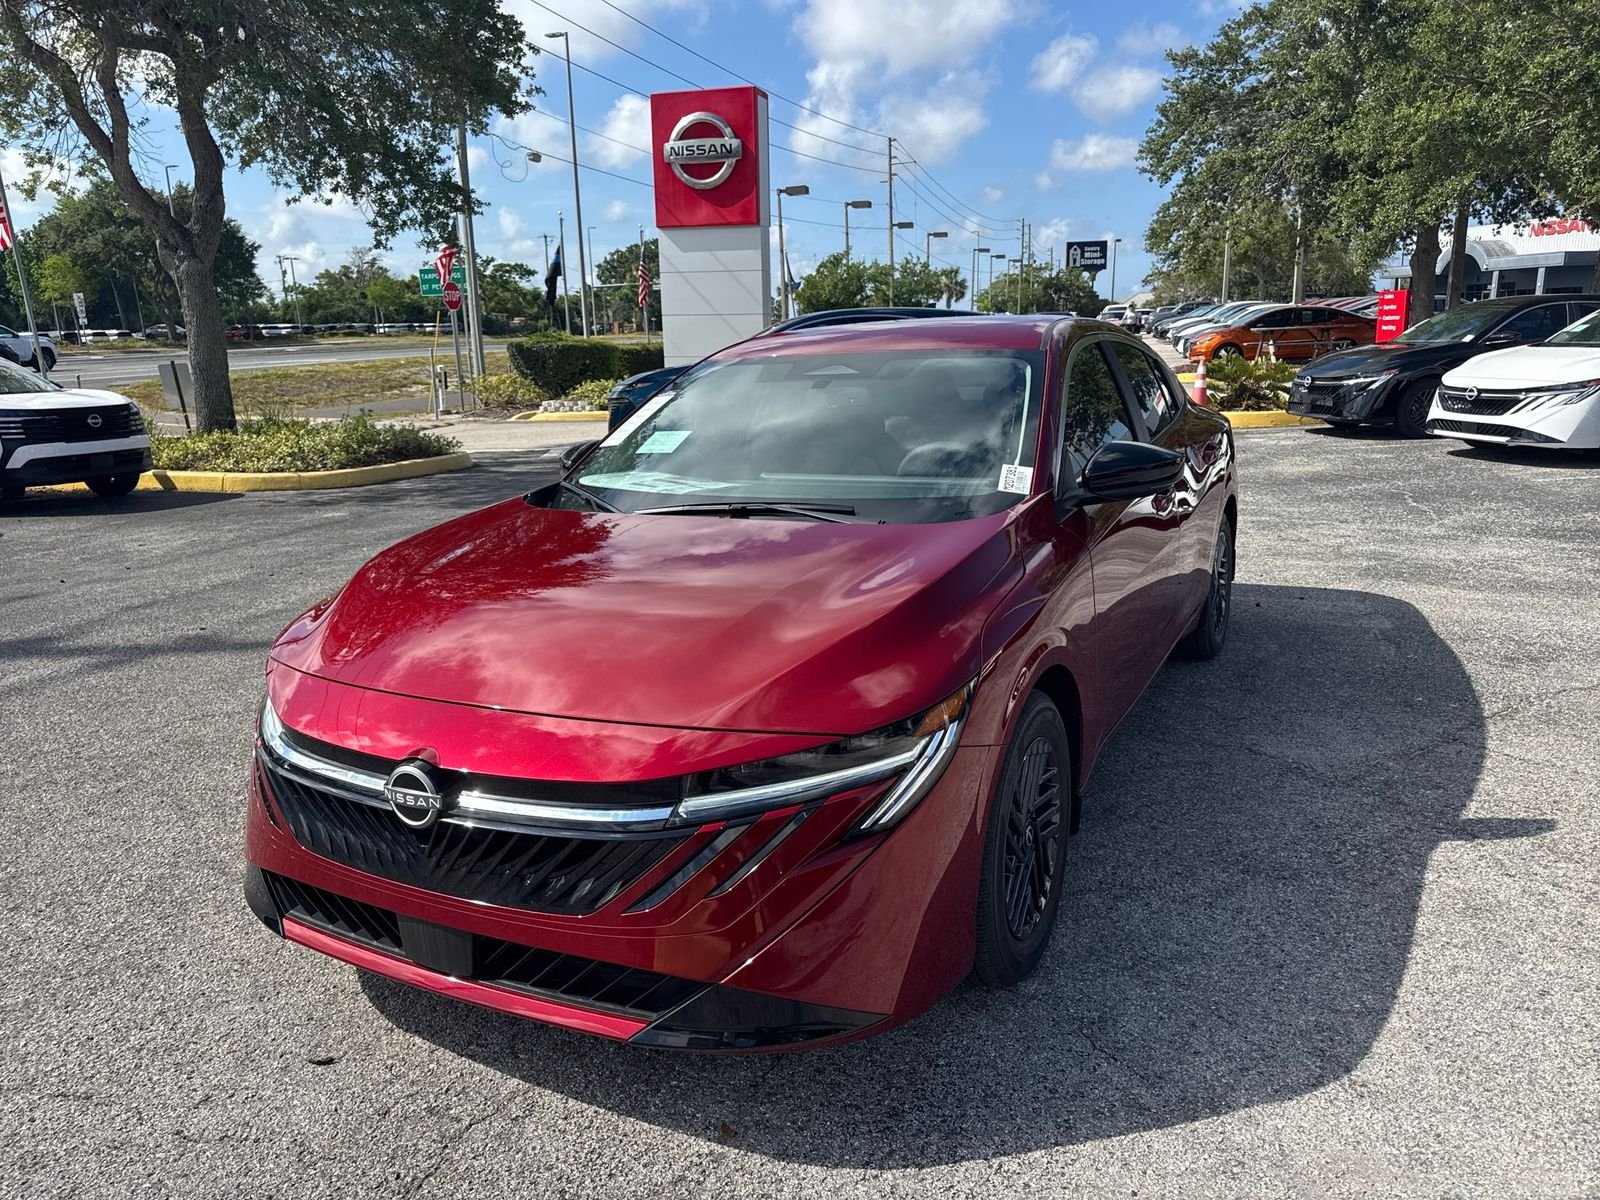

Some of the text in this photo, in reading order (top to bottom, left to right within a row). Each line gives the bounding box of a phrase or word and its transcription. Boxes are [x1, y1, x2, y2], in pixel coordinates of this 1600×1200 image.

[669, 143, 733, 157] NISSAN
[444, 290, 461, 302] STOP
[384, 788, 440, 808] NISSAN
